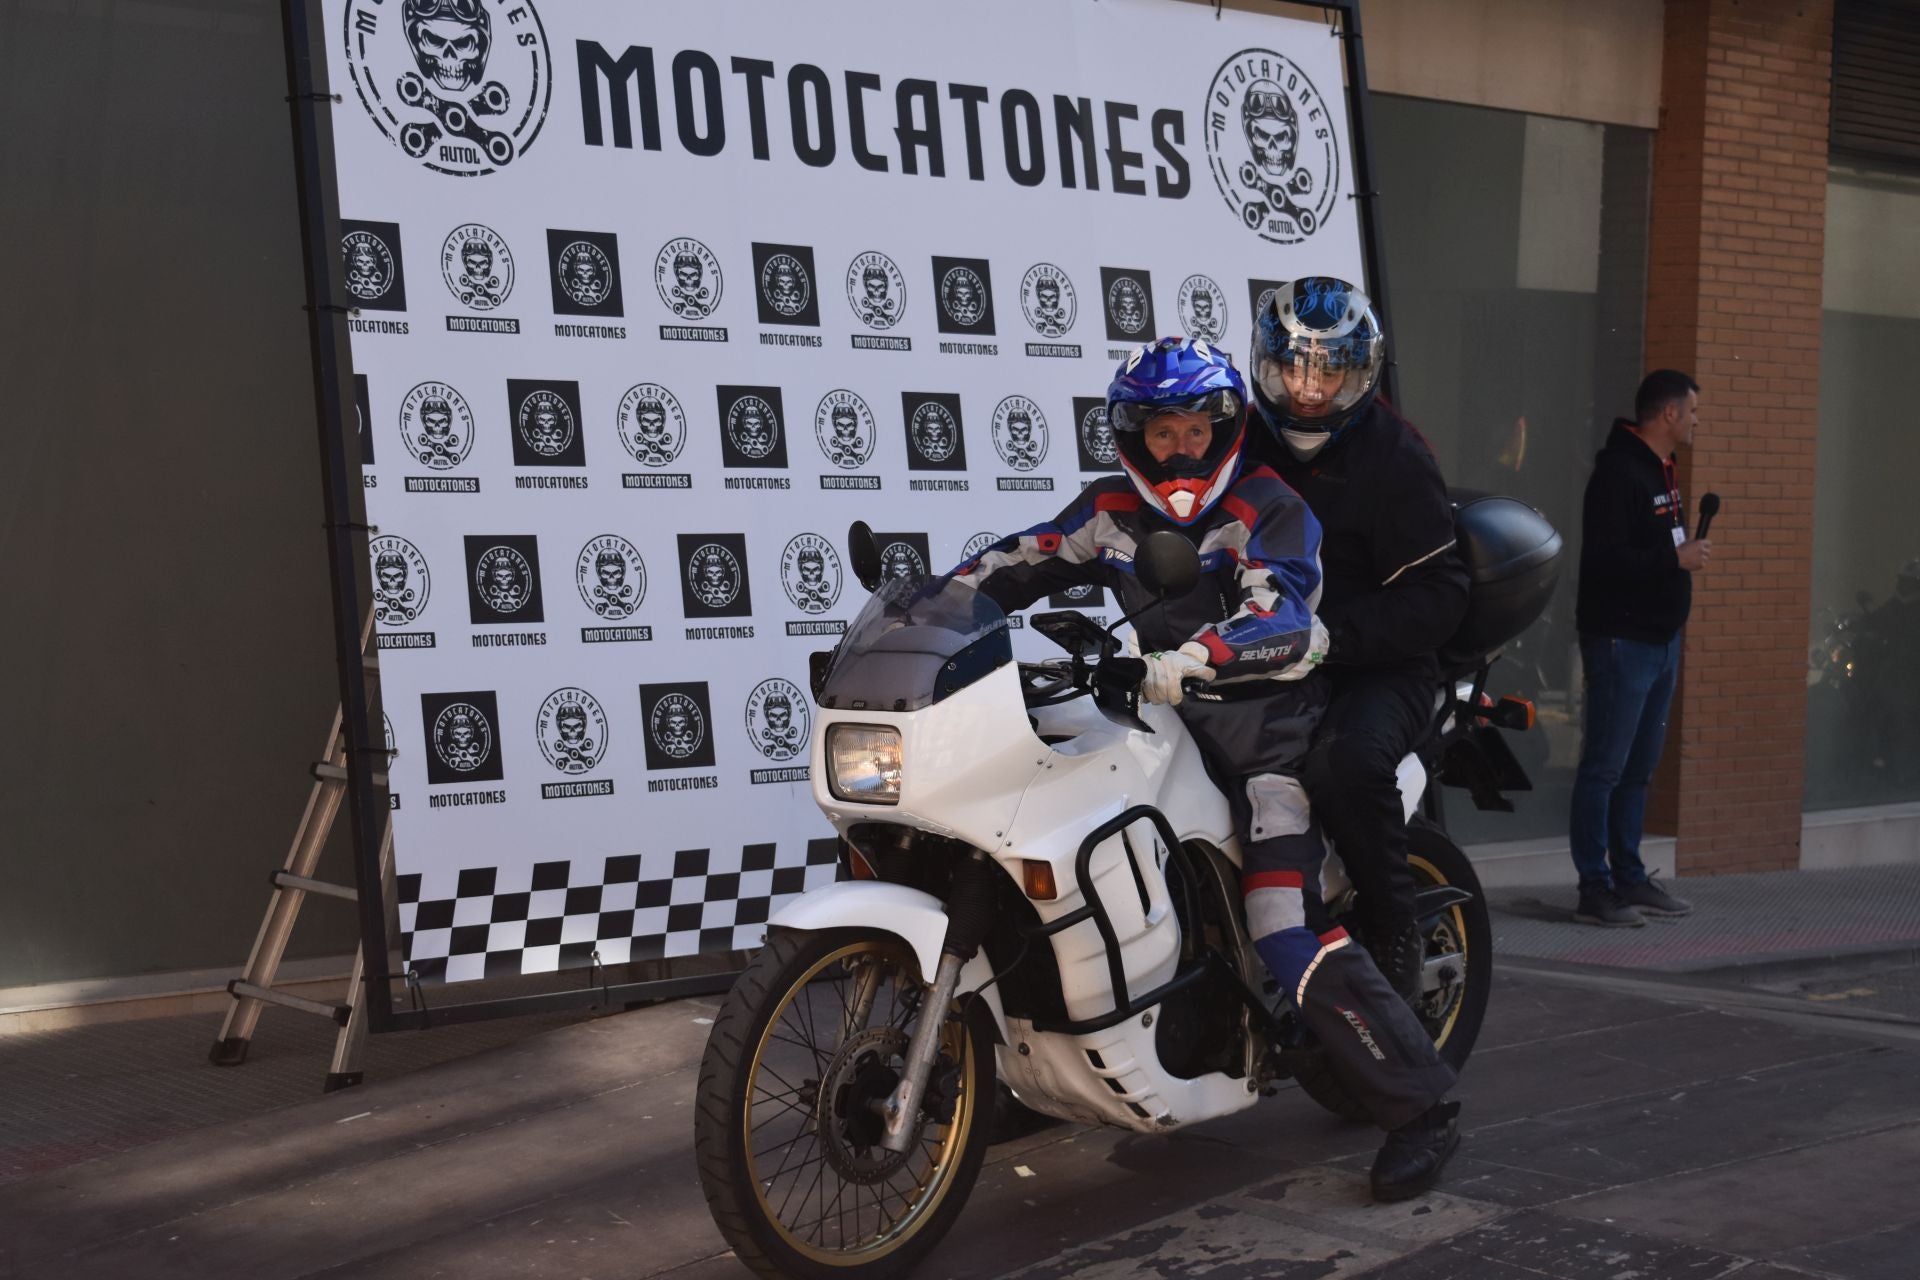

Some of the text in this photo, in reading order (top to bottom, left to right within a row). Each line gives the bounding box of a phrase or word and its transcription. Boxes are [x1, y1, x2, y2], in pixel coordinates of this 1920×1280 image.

[1212, 60, 1328, 139] MOTOCATONES
[576, 39, 1191, 199] MOTOCATONES
[440, 146, 480, 164] AUTOL
[1268, 220, 1295, 234] AUTOL
[342, 234, 390, 263] OTOCATONES
[349, 319, 409, 334] TOCATONES
[450, 318, 517, 333] MOTOCATONES
[554, 324, 626, 339] MOTOCATONES
[663, 327, 725, 341] MOTOCATONES
[760, 333, 822, 347] MOTOCATONES
[854, 336, 908, 350] MOTOCATONES
[939, 342, 998, 356] MOTOCATONES
[1028, 344, 1080, 358] MOTOCATONES
[409, 478, 476, 492] MOTOCATONES
[515, 476, 588, 489] MOTOCATONES
[626, 475, 689, 488] MOTOCATONES
[725, 477, 790, 490] MOTOCATONES
[823, 477, 878, 489] MOTOCATONES
[909, 479, 969, 491] MOTOCATONES
[1000, 479, 1051, 490] MOTOCATONES
[585, 628, 649, 641] MOTOCATONES
[686, 626, 754, 640] MOTOCATONES
[789, 623, 845, 635] MOTOCATONES
[377, 634, 432, 648] TOCATONES
[472, 633, 547, 647] MOTOCATONES
[1240, 644, 1293, 662] SEVENTY
[545, 782, 611, 797] MOTOCATONES
[648, 775, 718, 792] MOTOCATONES
[430, 790, 506, 808] MOTOCATONES
